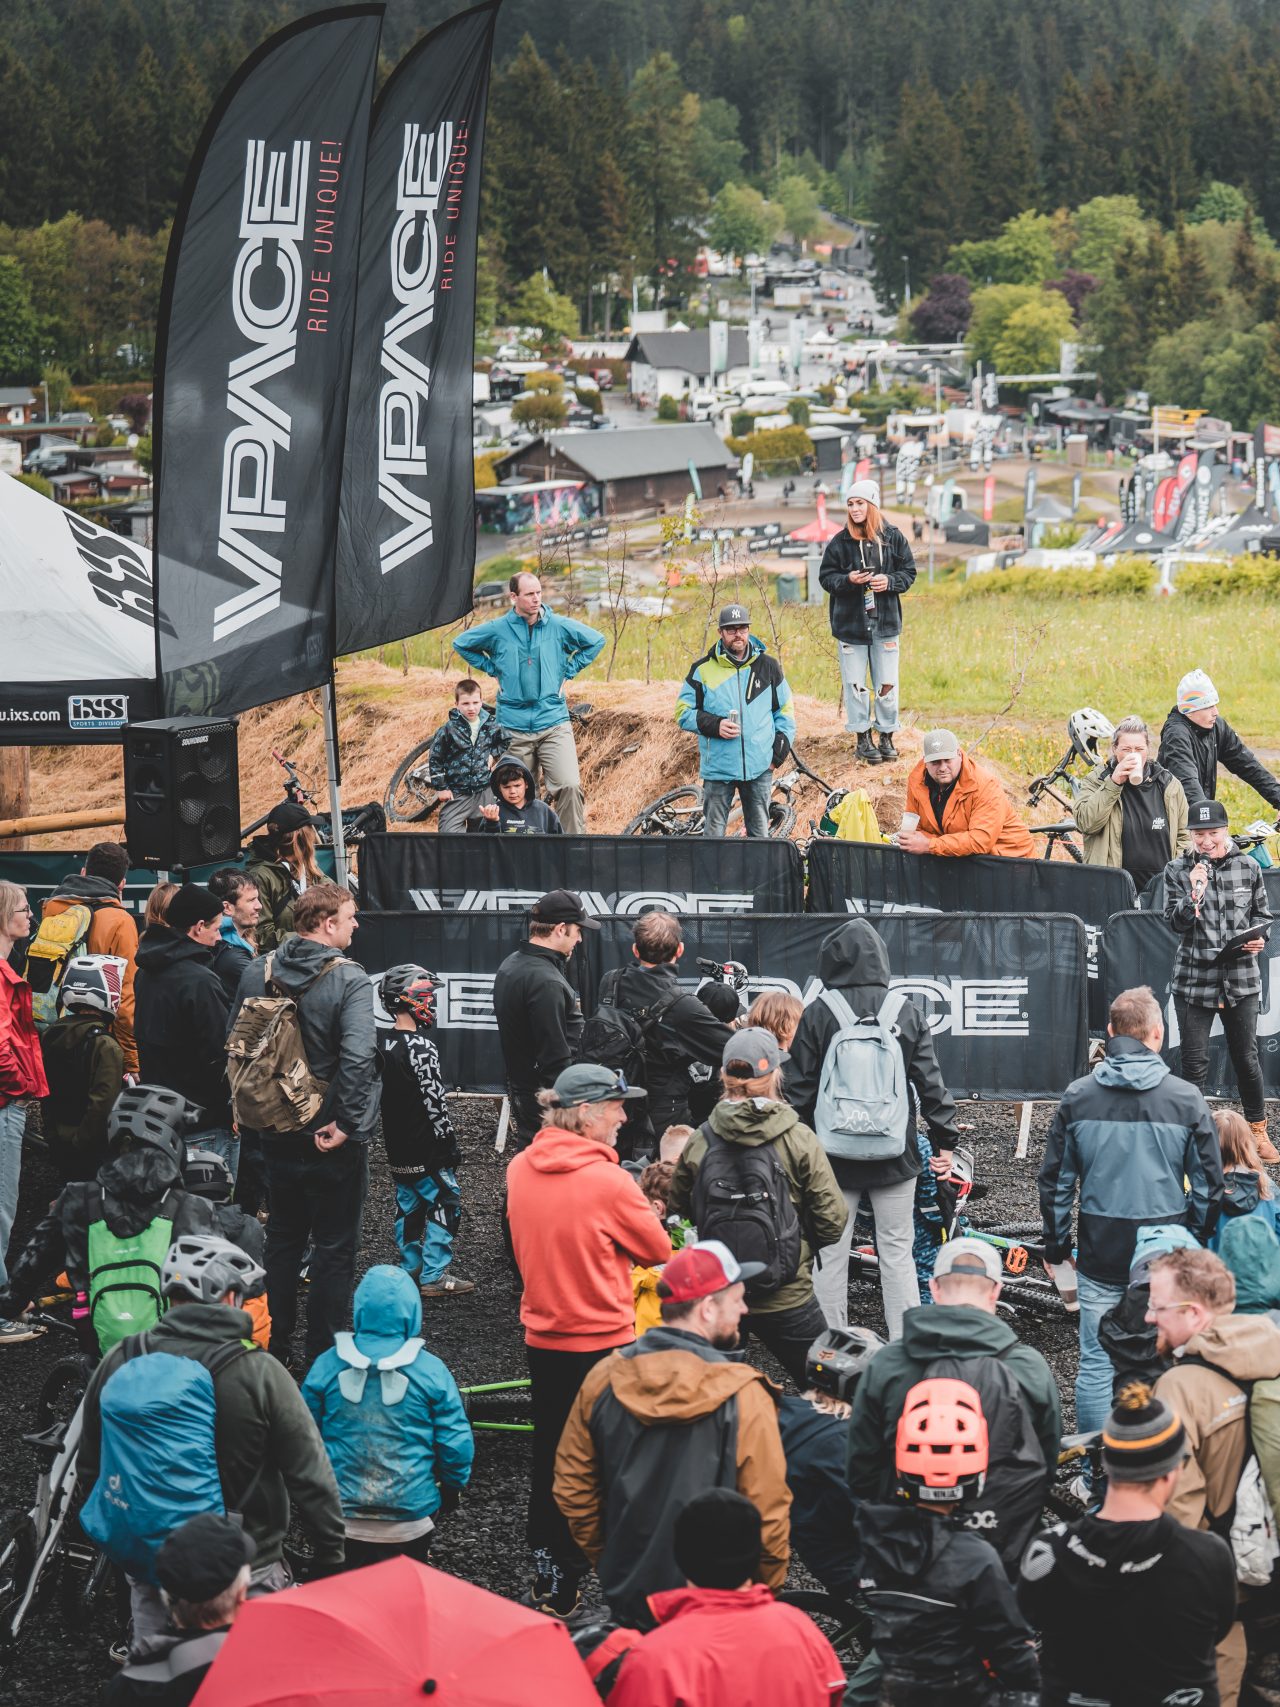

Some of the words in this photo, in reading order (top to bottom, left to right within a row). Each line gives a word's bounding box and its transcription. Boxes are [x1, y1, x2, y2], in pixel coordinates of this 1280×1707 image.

[314, 140, 343, 254] UNIQUE!
[446, 120, 469, 220] UNIQUE!
[306, 270, 331, 333] RIDE
[441, 234, 457, 290] RIDE
[213, 139, 311, 643] VPACE
[378, 121, 453, 575] VPACE
